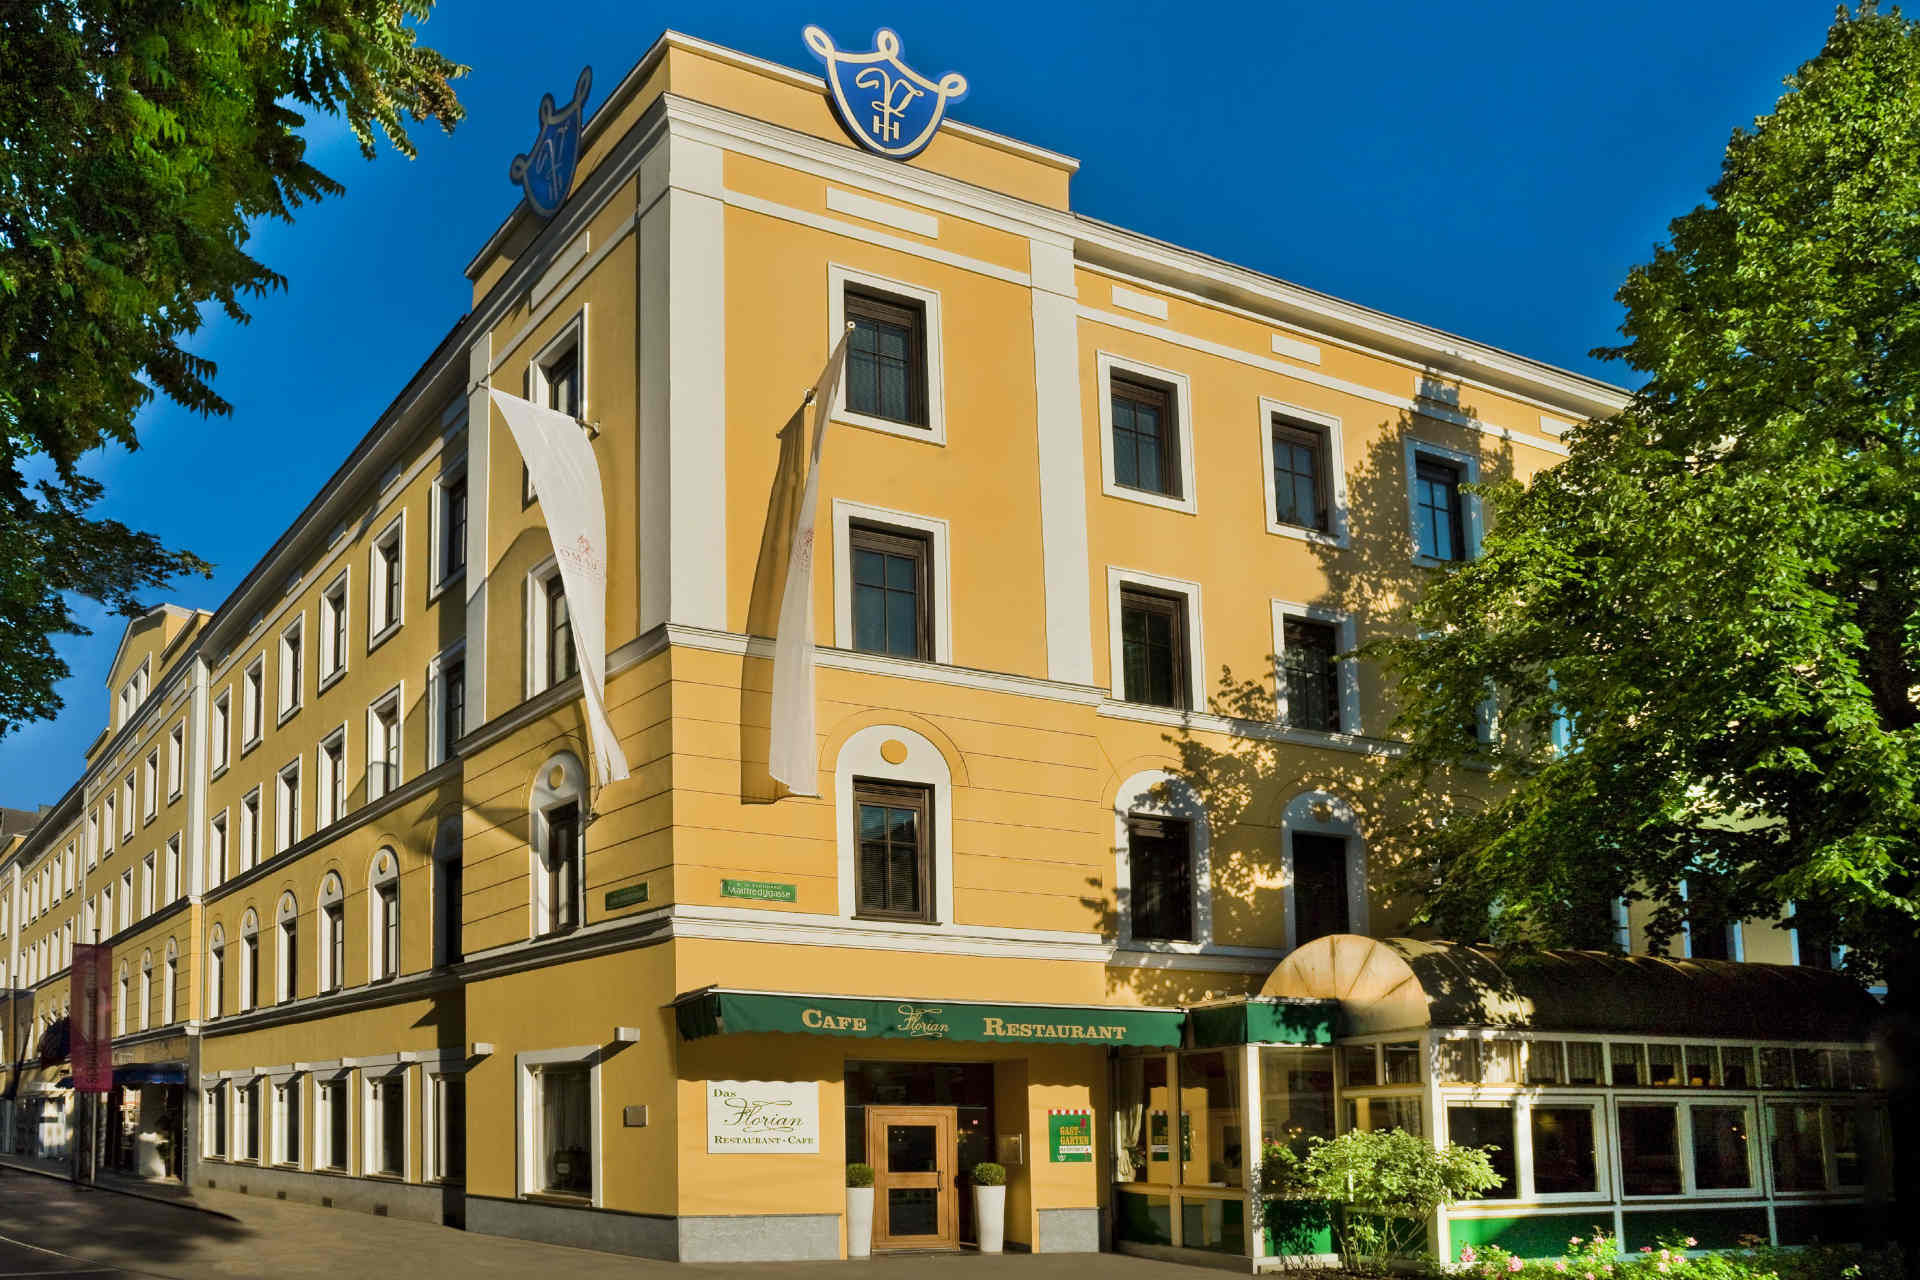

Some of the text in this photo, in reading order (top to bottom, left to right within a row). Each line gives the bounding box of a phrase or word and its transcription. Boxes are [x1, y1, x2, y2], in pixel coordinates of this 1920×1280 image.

[801, 1004, 1127, 1040] CAFE Florian RESTAURANT
[712, 1088, 737, 1098] Das
[723, 1097, 805, 1132] Florian
